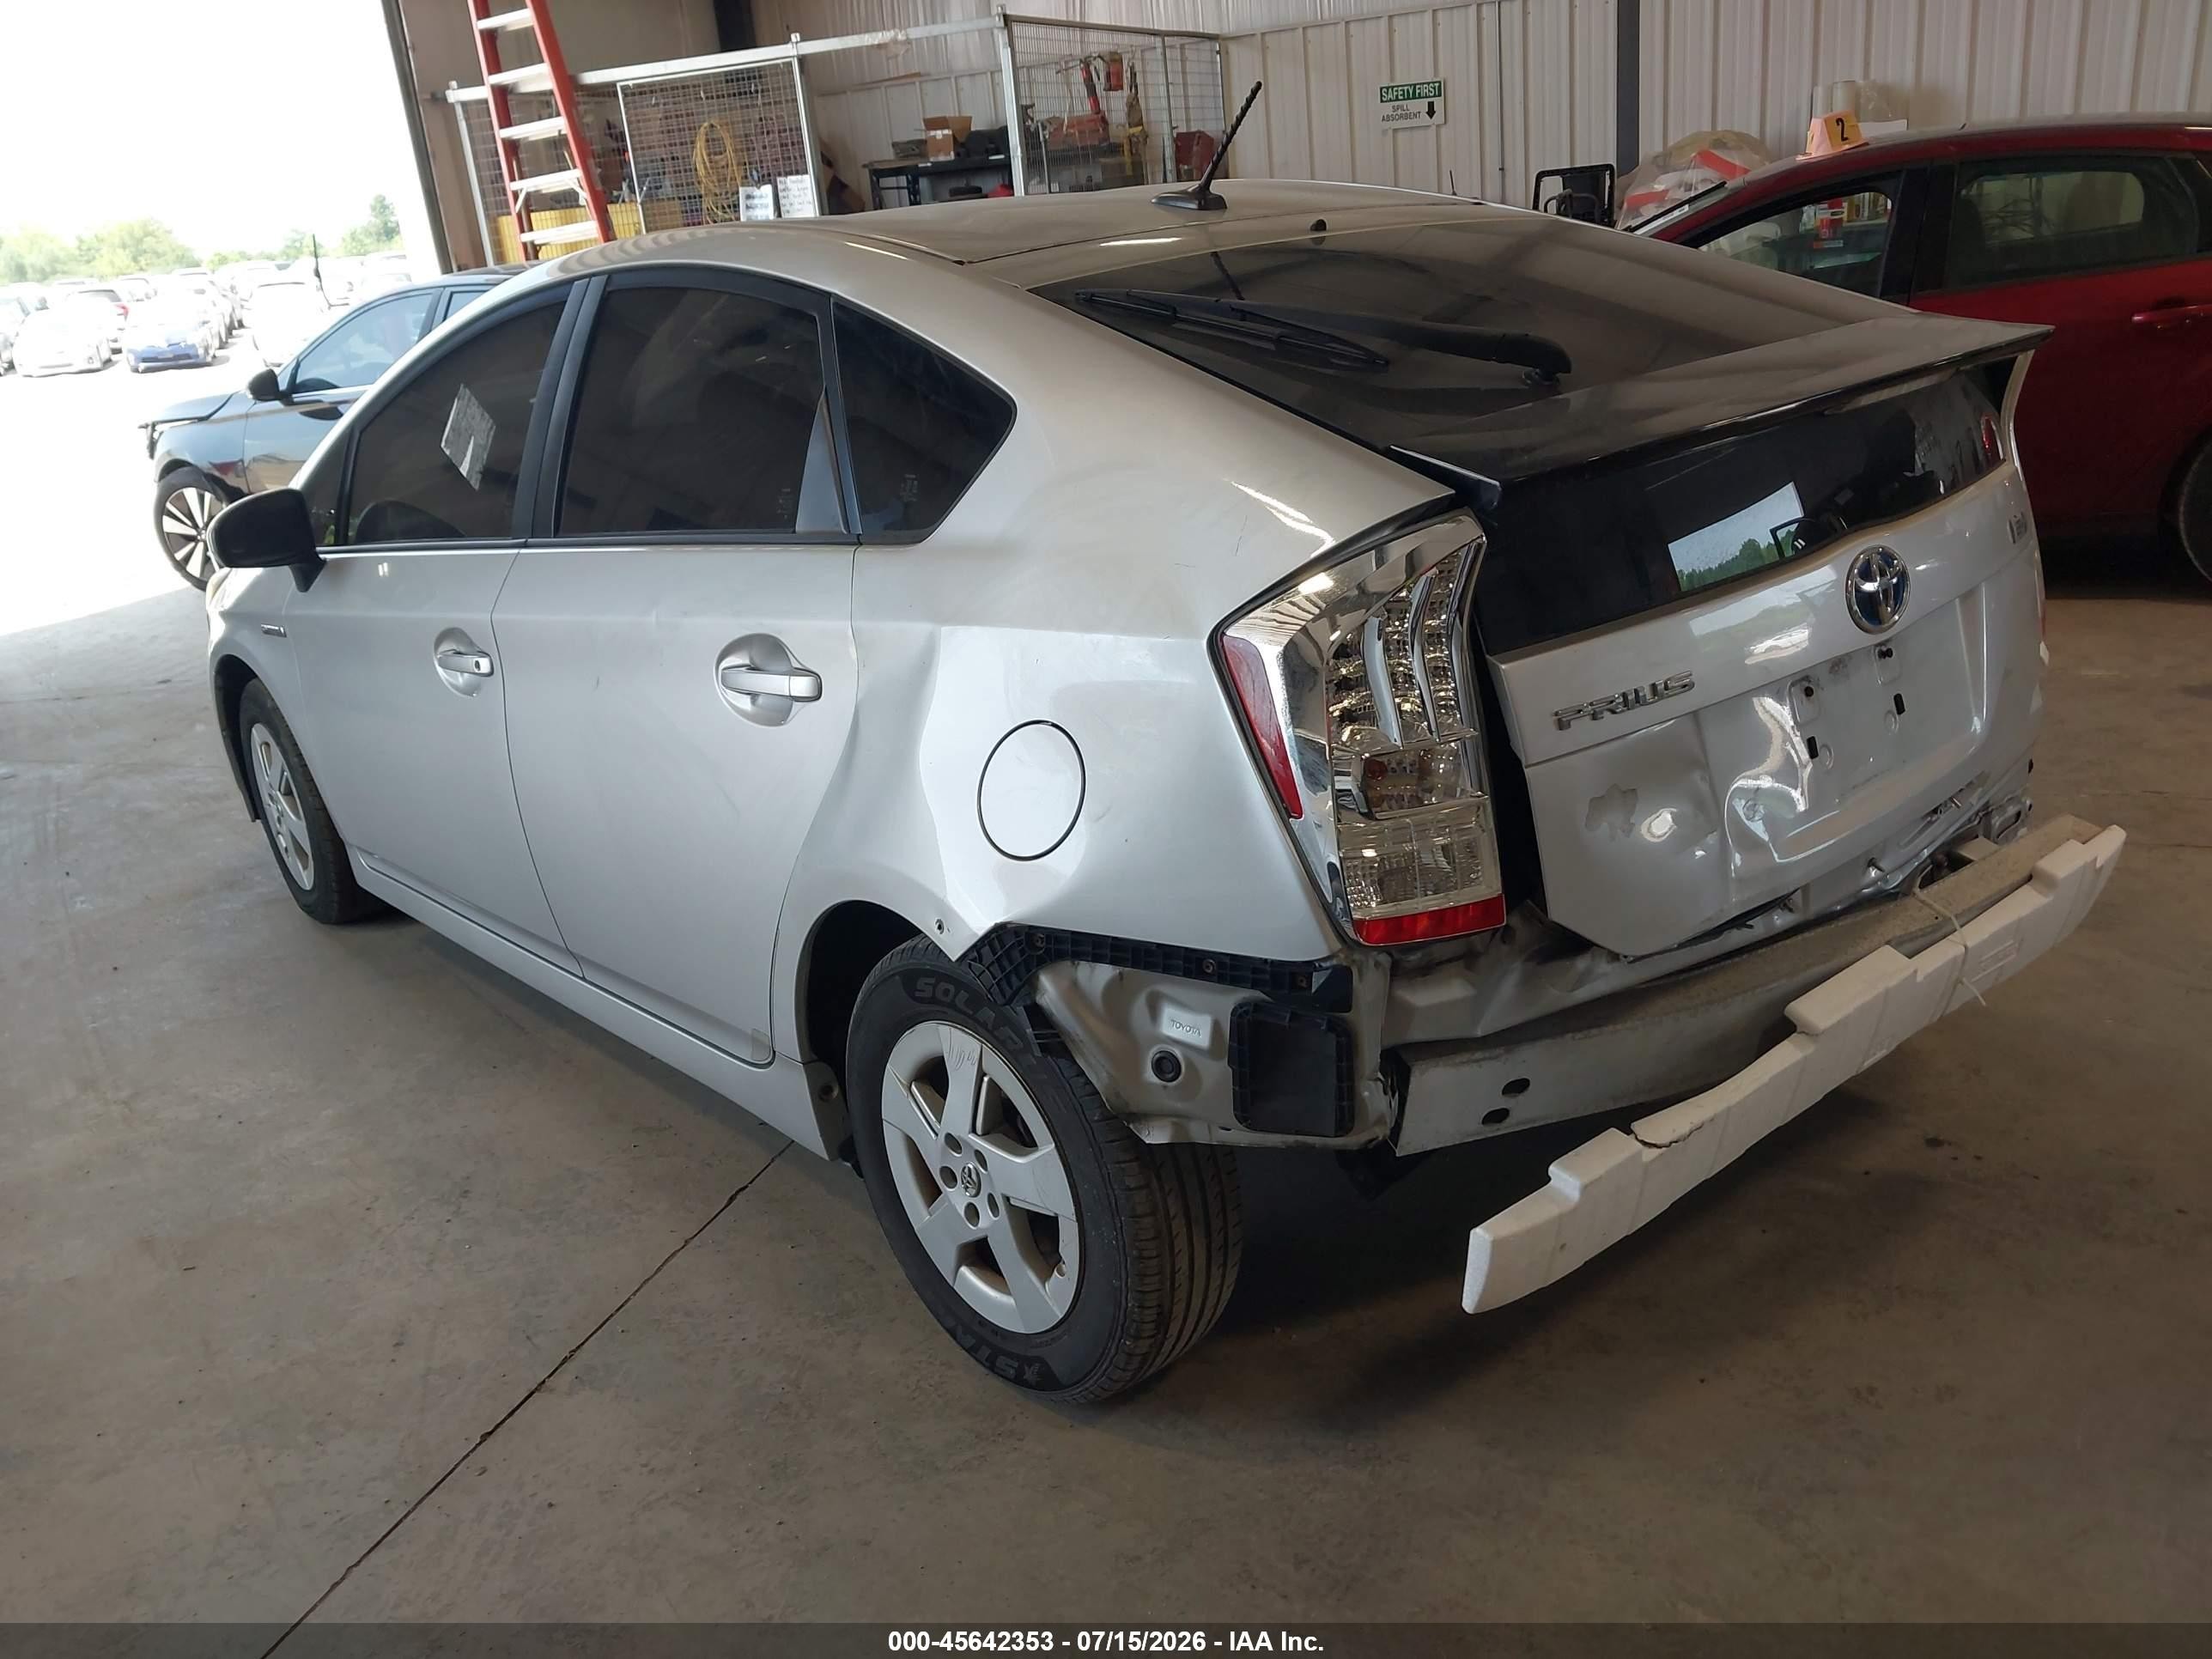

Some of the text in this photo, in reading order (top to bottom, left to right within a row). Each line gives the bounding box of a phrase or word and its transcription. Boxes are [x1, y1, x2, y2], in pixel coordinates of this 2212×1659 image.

[1382, 82, 1440, 101] SAFETY FIRST
[1381, 112, 1421, 122] ABSORBENT
[1391, 104, 1410, 112] SPILL
[1835, 117, 1849, 142] 2
[1553, 670, 1696, 731] PRIUS
[1170, 1018, 1201, 1036] TOYOTA
